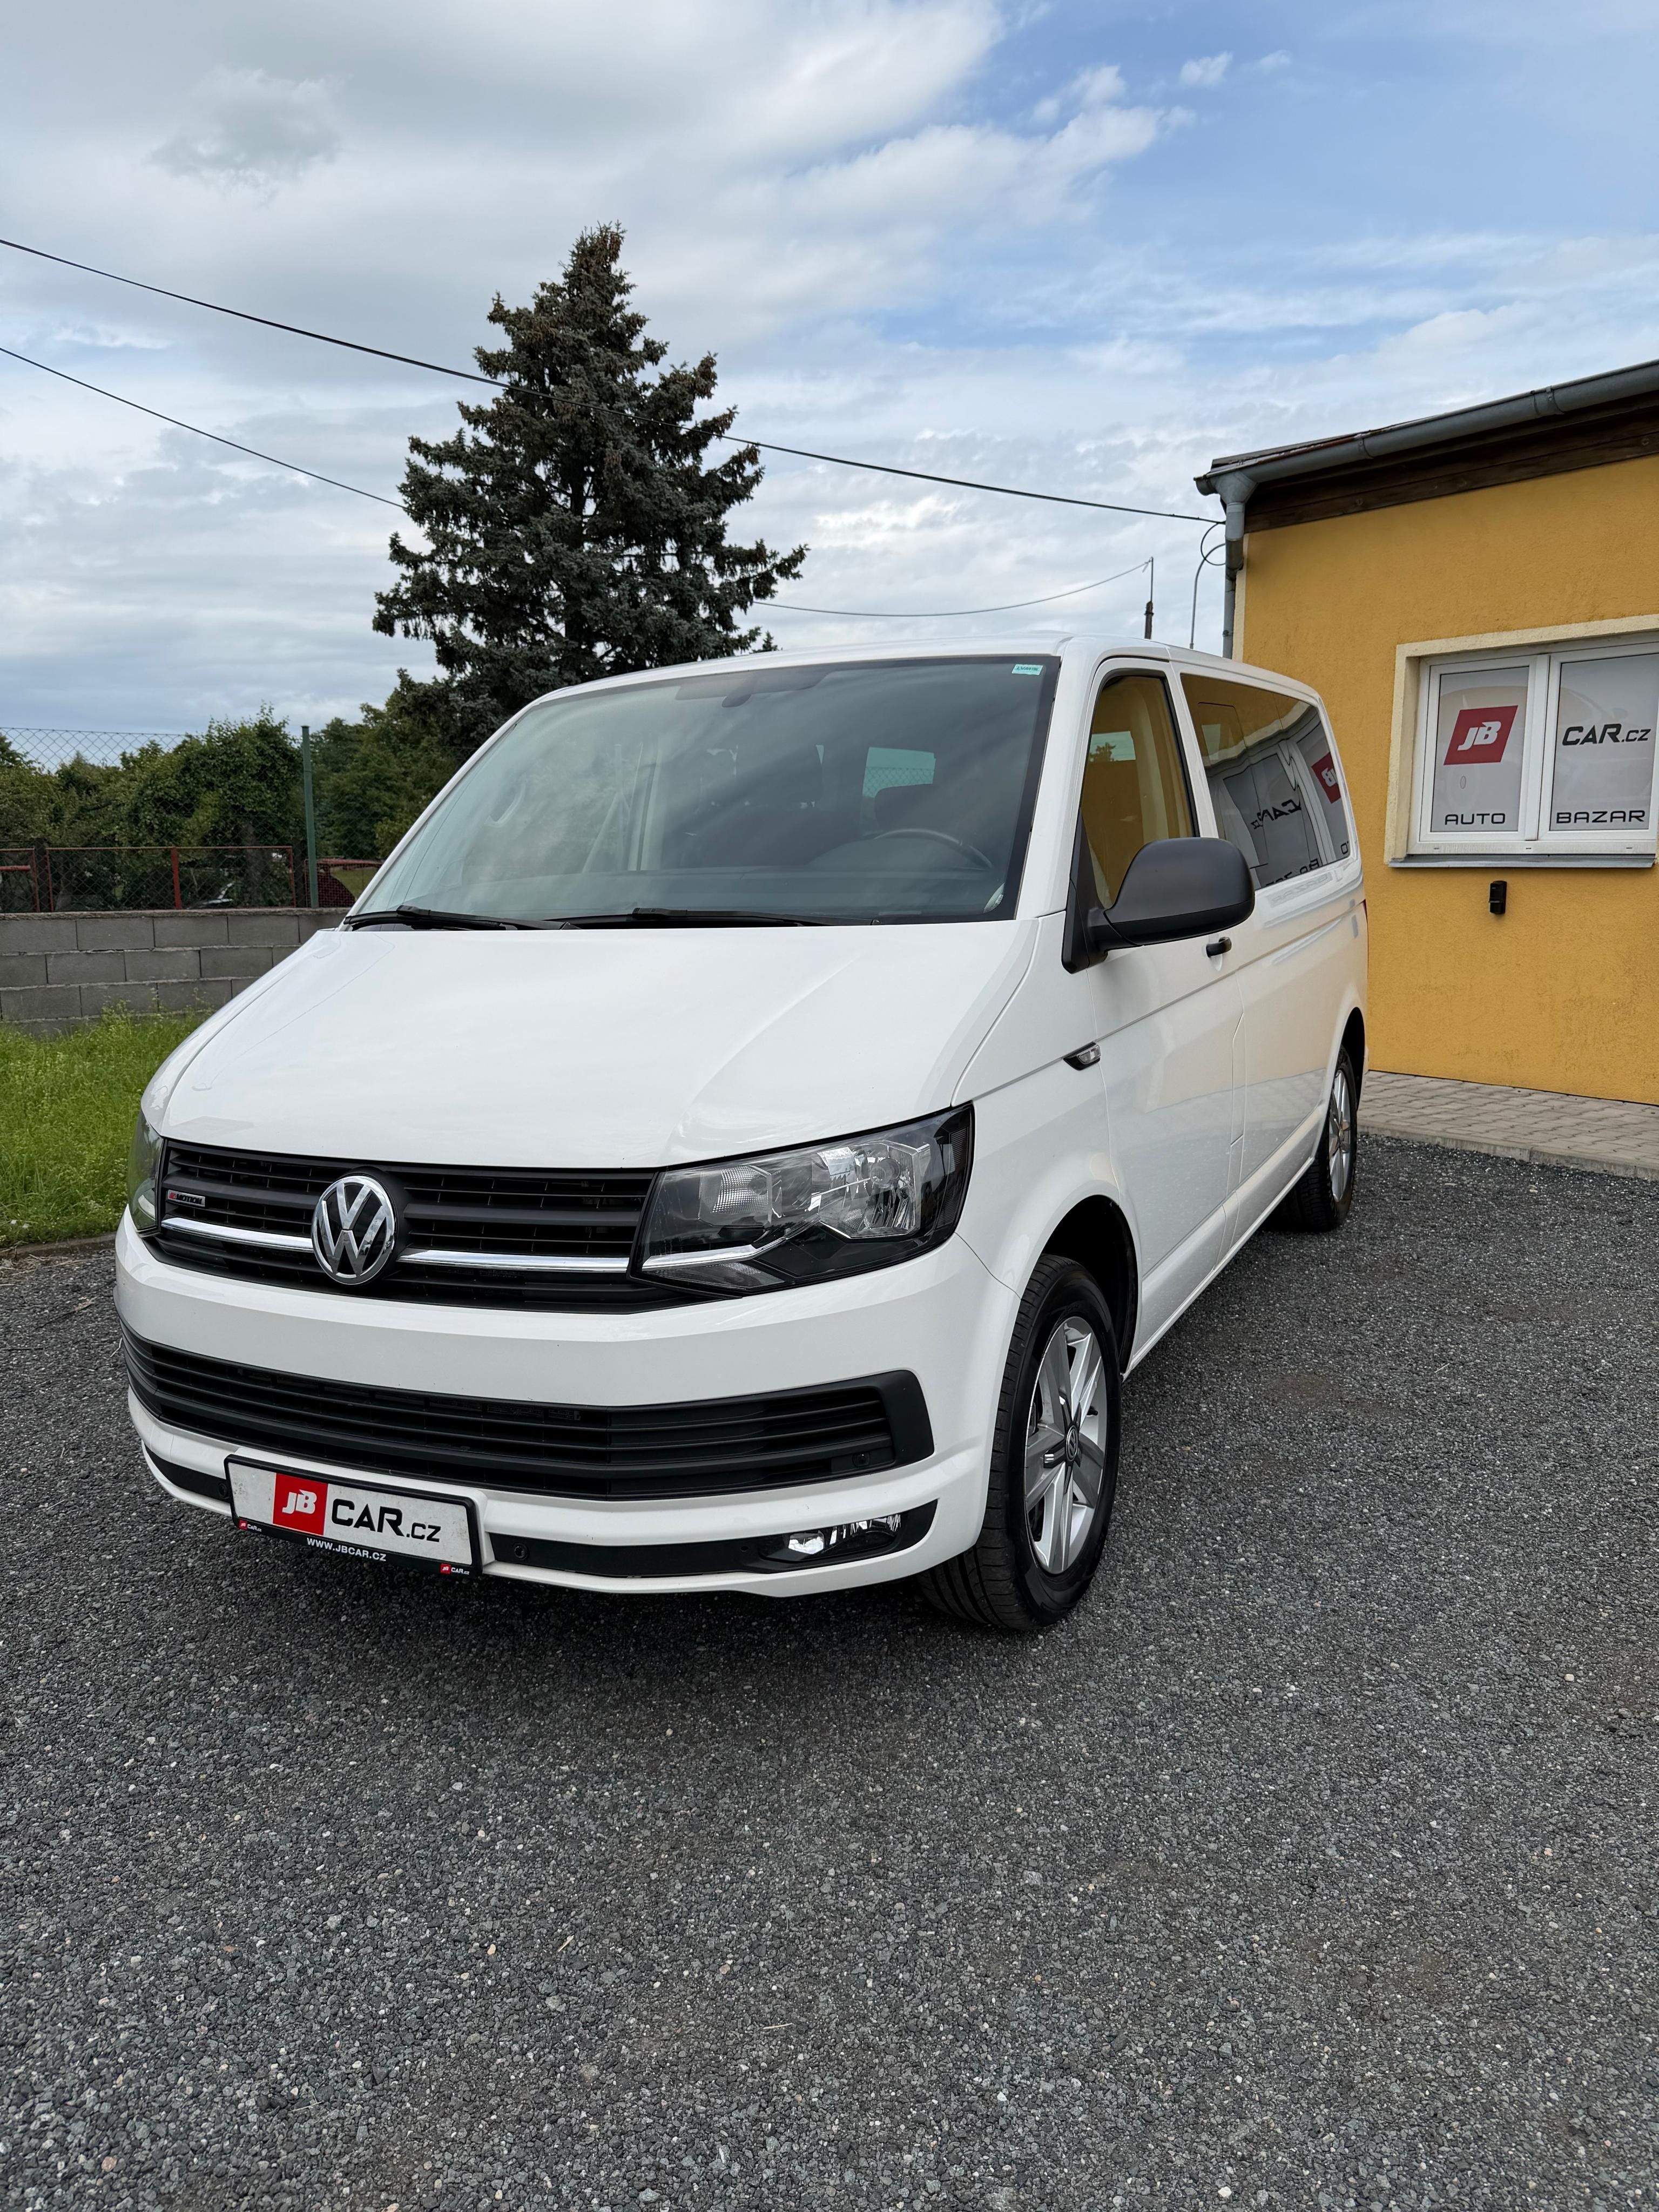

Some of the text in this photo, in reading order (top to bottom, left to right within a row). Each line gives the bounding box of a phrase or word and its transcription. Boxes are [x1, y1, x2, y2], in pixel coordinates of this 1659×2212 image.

[1457, 721, 1502, 751] JB
[1444, 810, 1645, 825] AUTO BAZAR
[282, 1489, 317, 1514] JB
[307, 1537, 387, 1562] WWW.JBCAR.CZ
